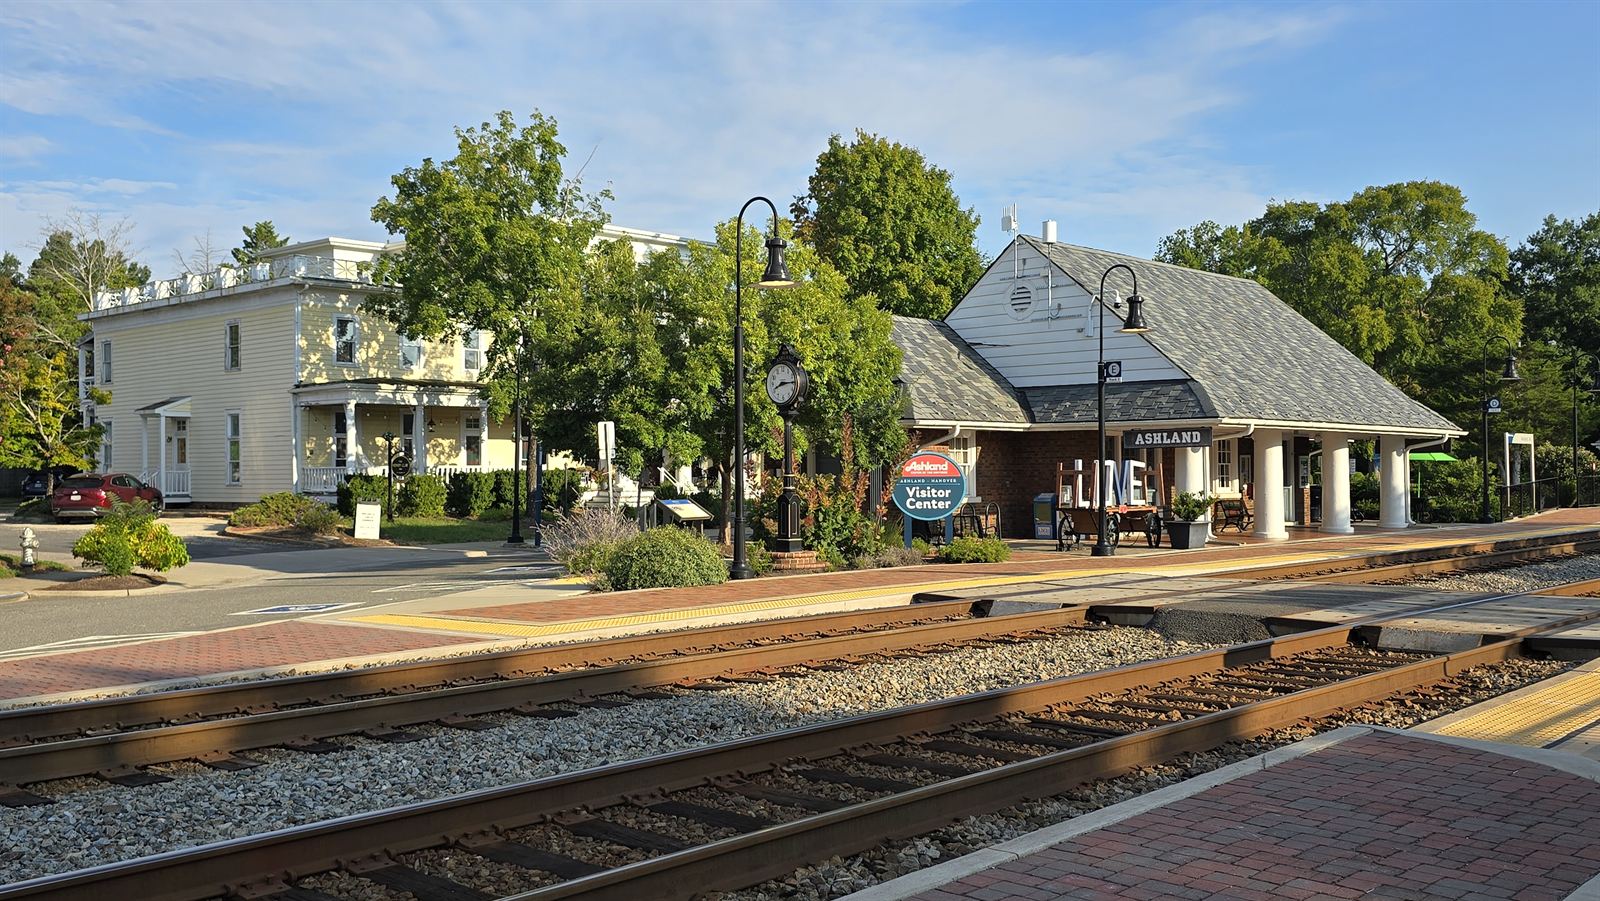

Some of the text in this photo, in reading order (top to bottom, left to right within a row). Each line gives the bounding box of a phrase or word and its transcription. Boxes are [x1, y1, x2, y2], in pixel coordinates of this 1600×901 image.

[1111, 365, 1117, 374] E
[1135, 431, 1201, 445] ASHLAND
[905, 461, 947, 472] Ashland
[906, 486, 951, 498] Visitor
[906, 497, 951, 509] Center
